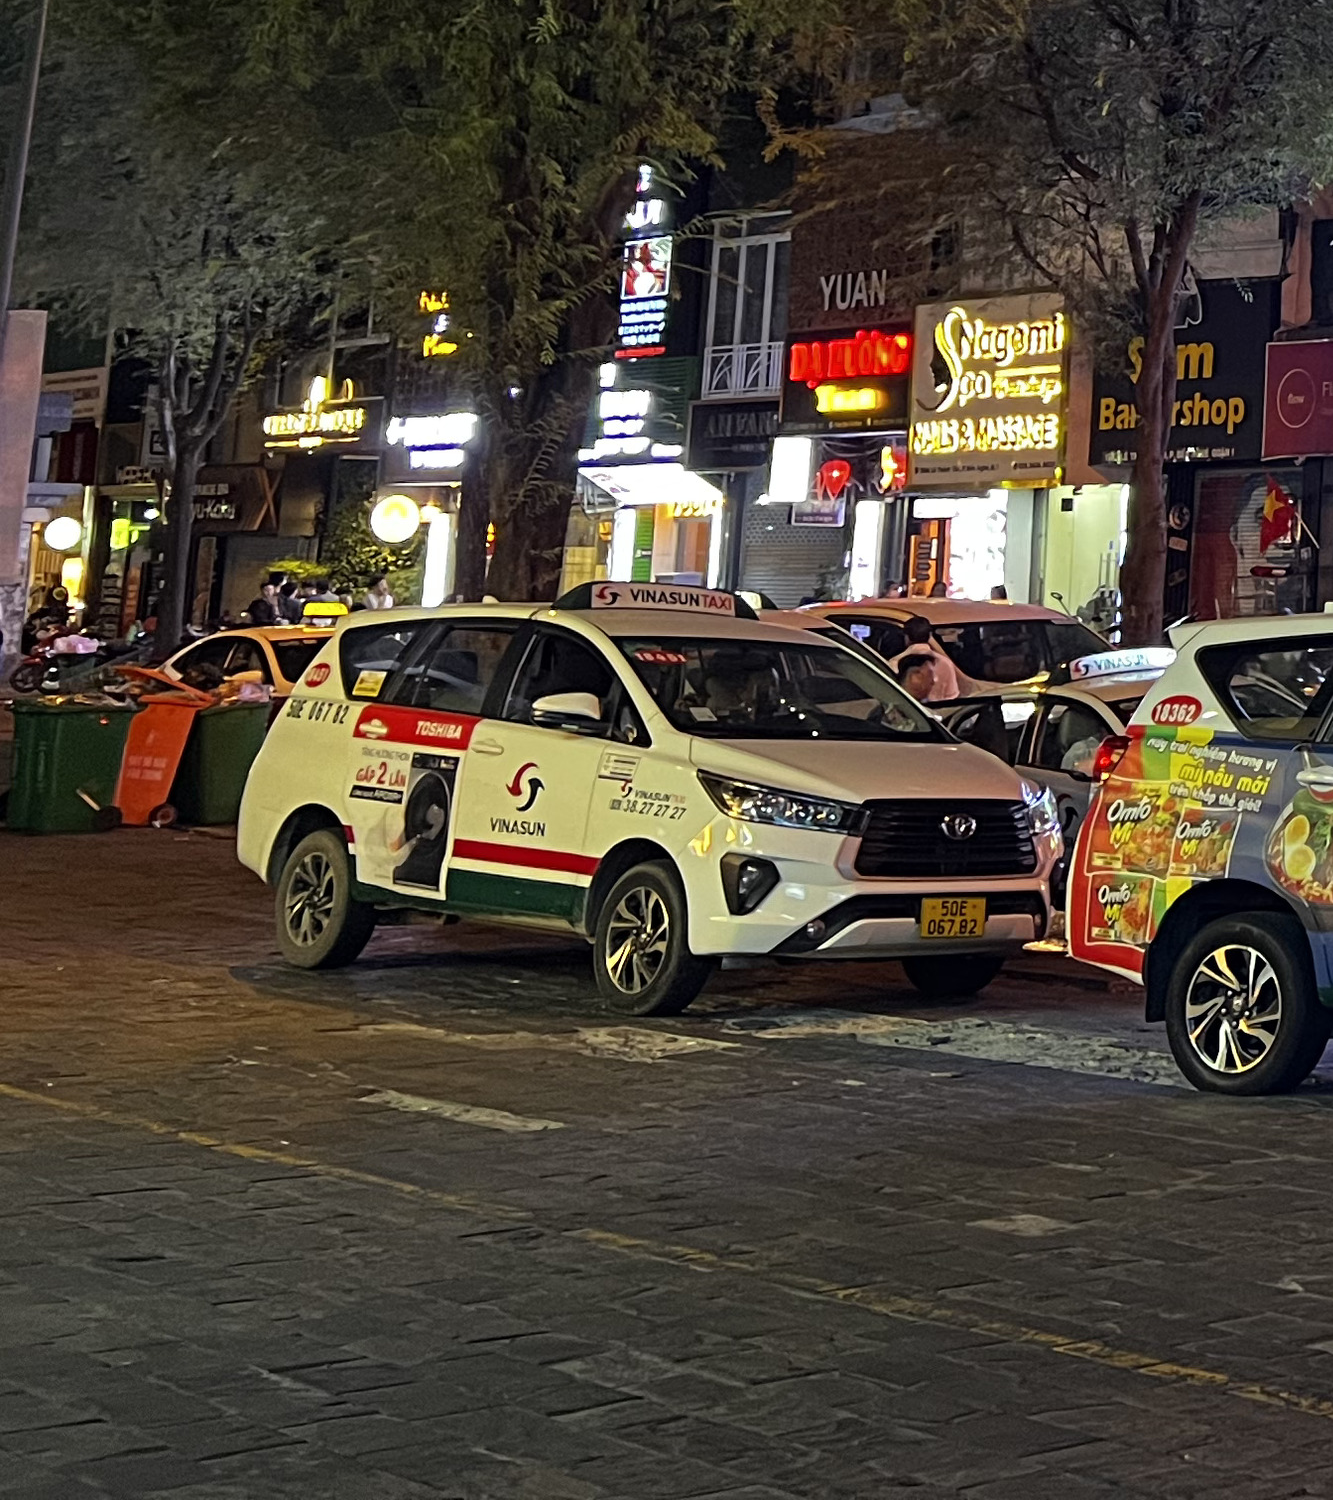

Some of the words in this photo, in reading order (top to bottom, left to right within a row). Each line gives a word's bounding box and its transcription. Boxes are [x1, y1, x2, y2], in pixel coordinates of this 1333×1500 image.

[820, 269, 888, 311] YUAN
[1127, 335, 1215, 385] Sm
[1099, 391, 1246, 435] Barrshop
[308, 701, 334, 722] 067
[332, 704, 350, 725] 82
[1153, 703, 1198, 723] 18362
[415, 720, 464, 740] TOSHIBA
[376, 762, 389, 785] 2
[653, 803, 670, 819] 27
[669, 806, 688, 821] 27
[490, 817, 547, 837] VINASUN
[940, 900, 969, 917] 50E
